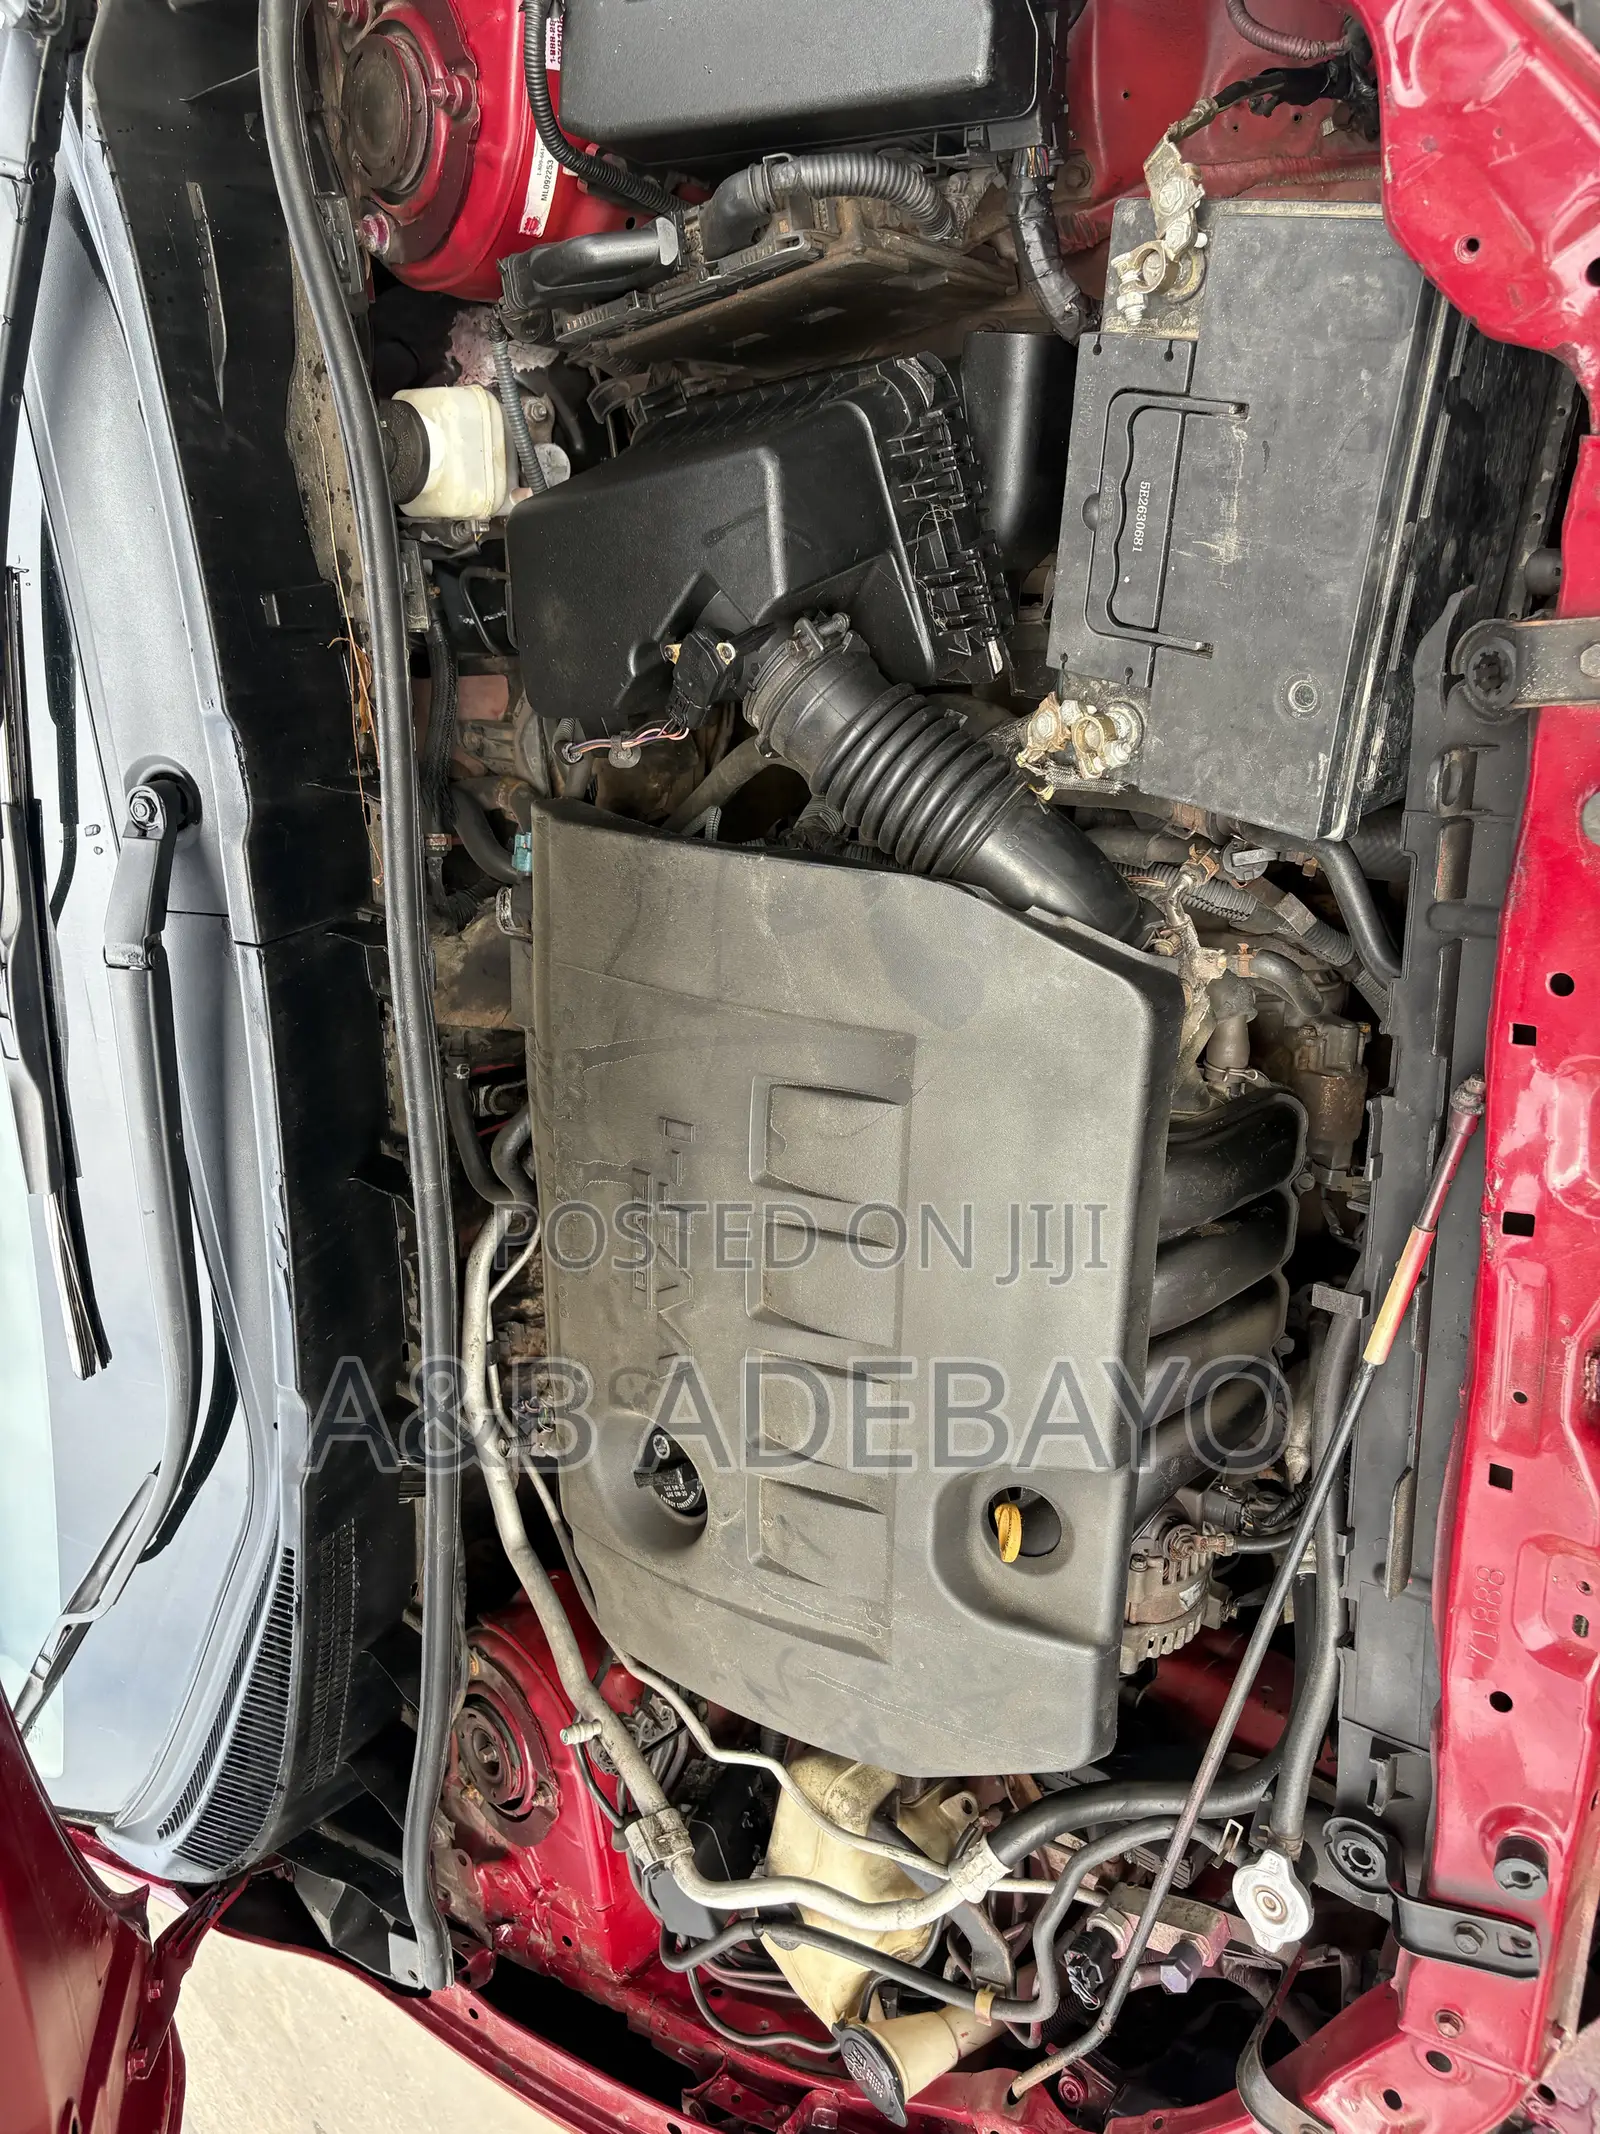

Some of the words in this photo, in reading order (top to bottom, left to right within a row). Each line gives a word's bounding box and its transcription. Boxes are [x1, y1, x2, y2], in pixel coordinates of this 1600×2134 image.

[537, 142, 546, 176] 1-800-661-
[540, 159, 554, 201] ML092253
[1465, 1565, 1505, 1661] 71888
